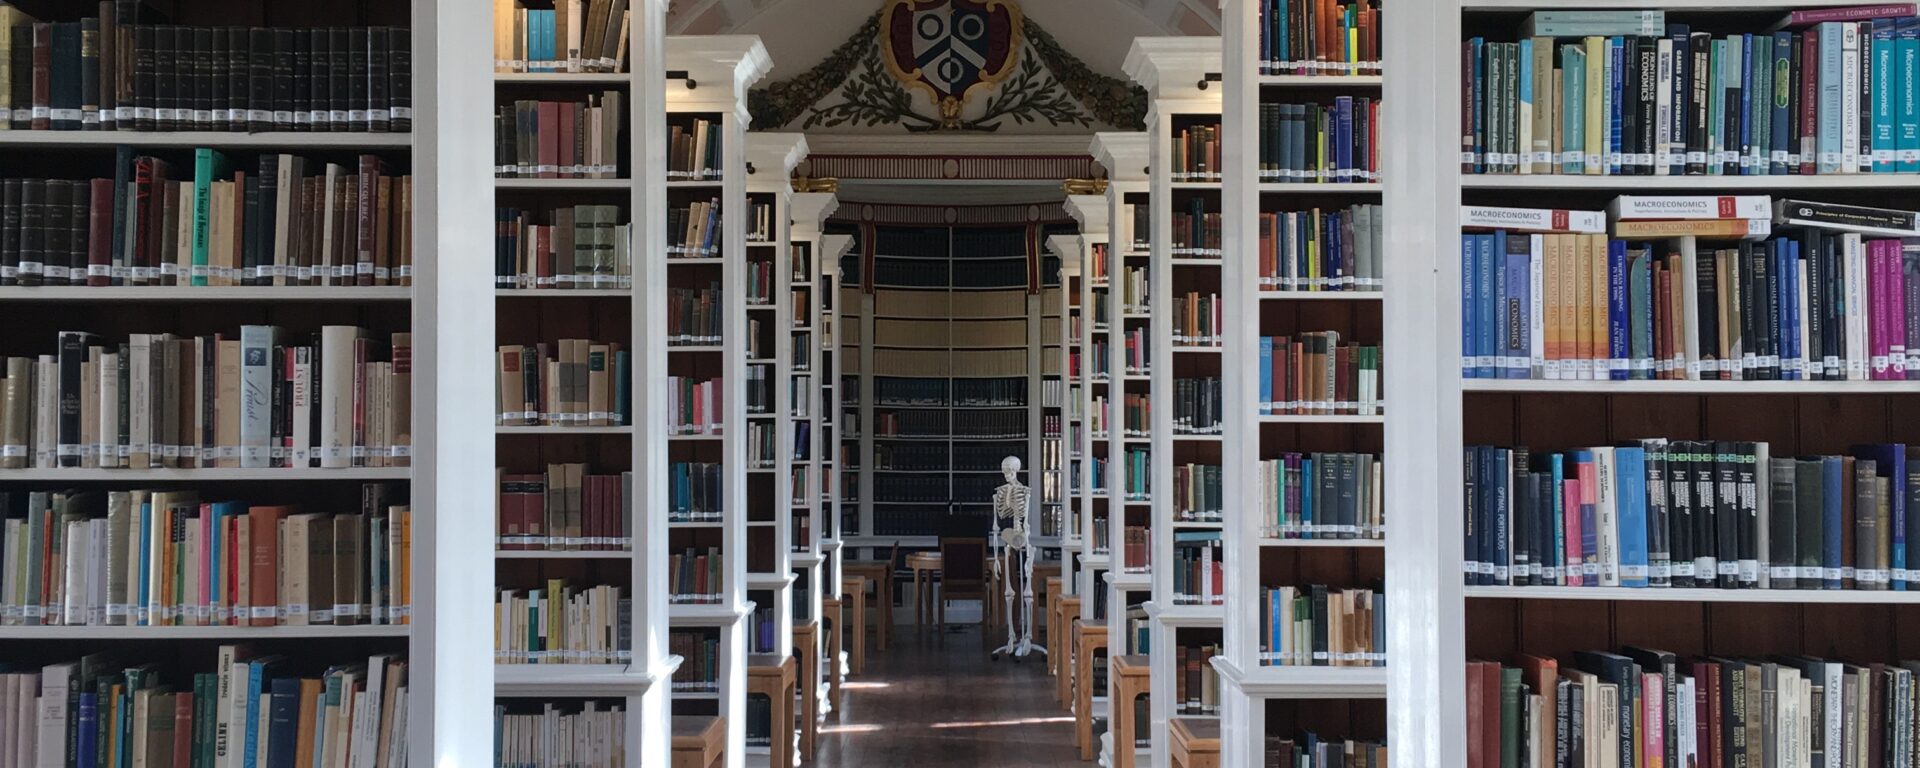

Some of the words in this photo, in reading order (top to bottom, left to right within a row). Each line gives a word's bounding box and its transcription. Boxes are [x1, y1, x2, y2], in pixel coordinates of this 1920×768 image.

[1641, 52, 1649, 101] ECONOMICS
[1905, 49, 1914, 115] Microeconomics
[1649, 92, 1656, 101] OF
[1846, 55, 1854, 135] MICROECONOMICS
[197, 187, 207, 197] The
[197, 198, 207, 214] Image
[1470, 210, 1541, 220] MACROECONOMICS
[1629, 223, 1714, 231] MACROECONOMICS
[1464, 241, 1472, 298] MACROECONOMICS
[1481, 240, 1490, 298] MACROECONOMICS
[1497, 266, 1505, 286] Topics
[1533, 259, 1541, 270] The
[1533, 271, 1541, 299] Japanese
[1497, 297, 1505, 349] Microeconomics
[245, 378, 268, 421] Proust
[295, 368, 303, 407] PROUST
[1667, 663, 1676, 692] MONETARY
[1830, 675, 1838, 711] MONETARY
[1621, 705, 1631, 738] monetary
[1667, 694, 1676, 725] ECONOMICS
[1846, 712, 1854, 721] The
[1830, 713, 1838, 735] THEORY
[1846, 722, 1854, 741] Political
[1623, 740, 1631, 768] economi
[1830, 736, 1838, 753] AND
